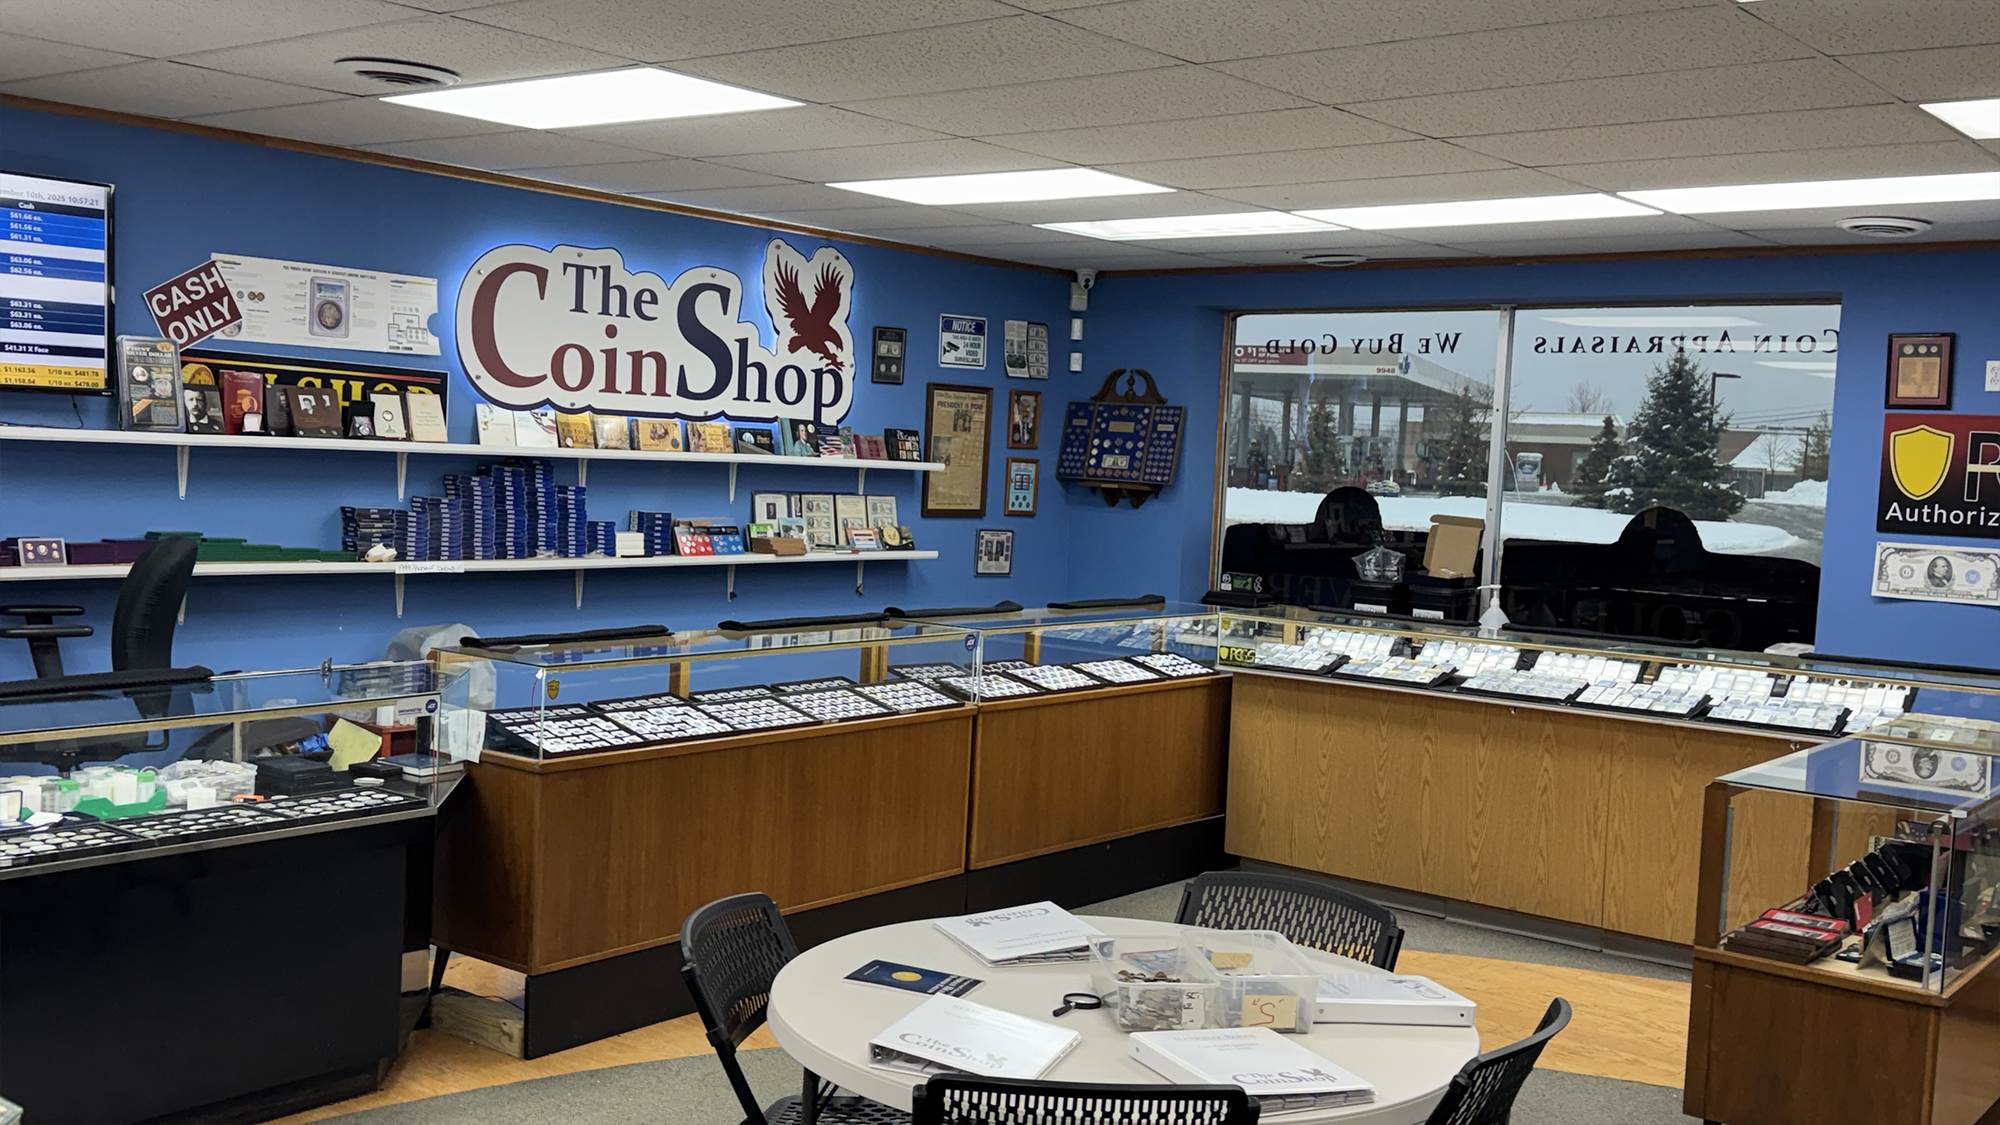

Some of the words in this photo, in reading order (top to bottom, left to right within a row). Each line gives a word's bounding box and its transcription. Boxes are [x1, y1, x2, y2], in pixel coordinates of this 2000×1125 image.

[18, 202, 35, 210] Cash
[47, 194, 66, 202] 2025
[68, 196, 99, 206] 10:57:21
[151, 267, 226, 318] CASH
[562, 262, 658, 321] The
[168, 296, 232, 345] ONLY
[952, 320, 976, 332] NOTICE
[937, 401, 963, 409] PRESIDENT
[1885, 502, 2000, 526] Authoriz
